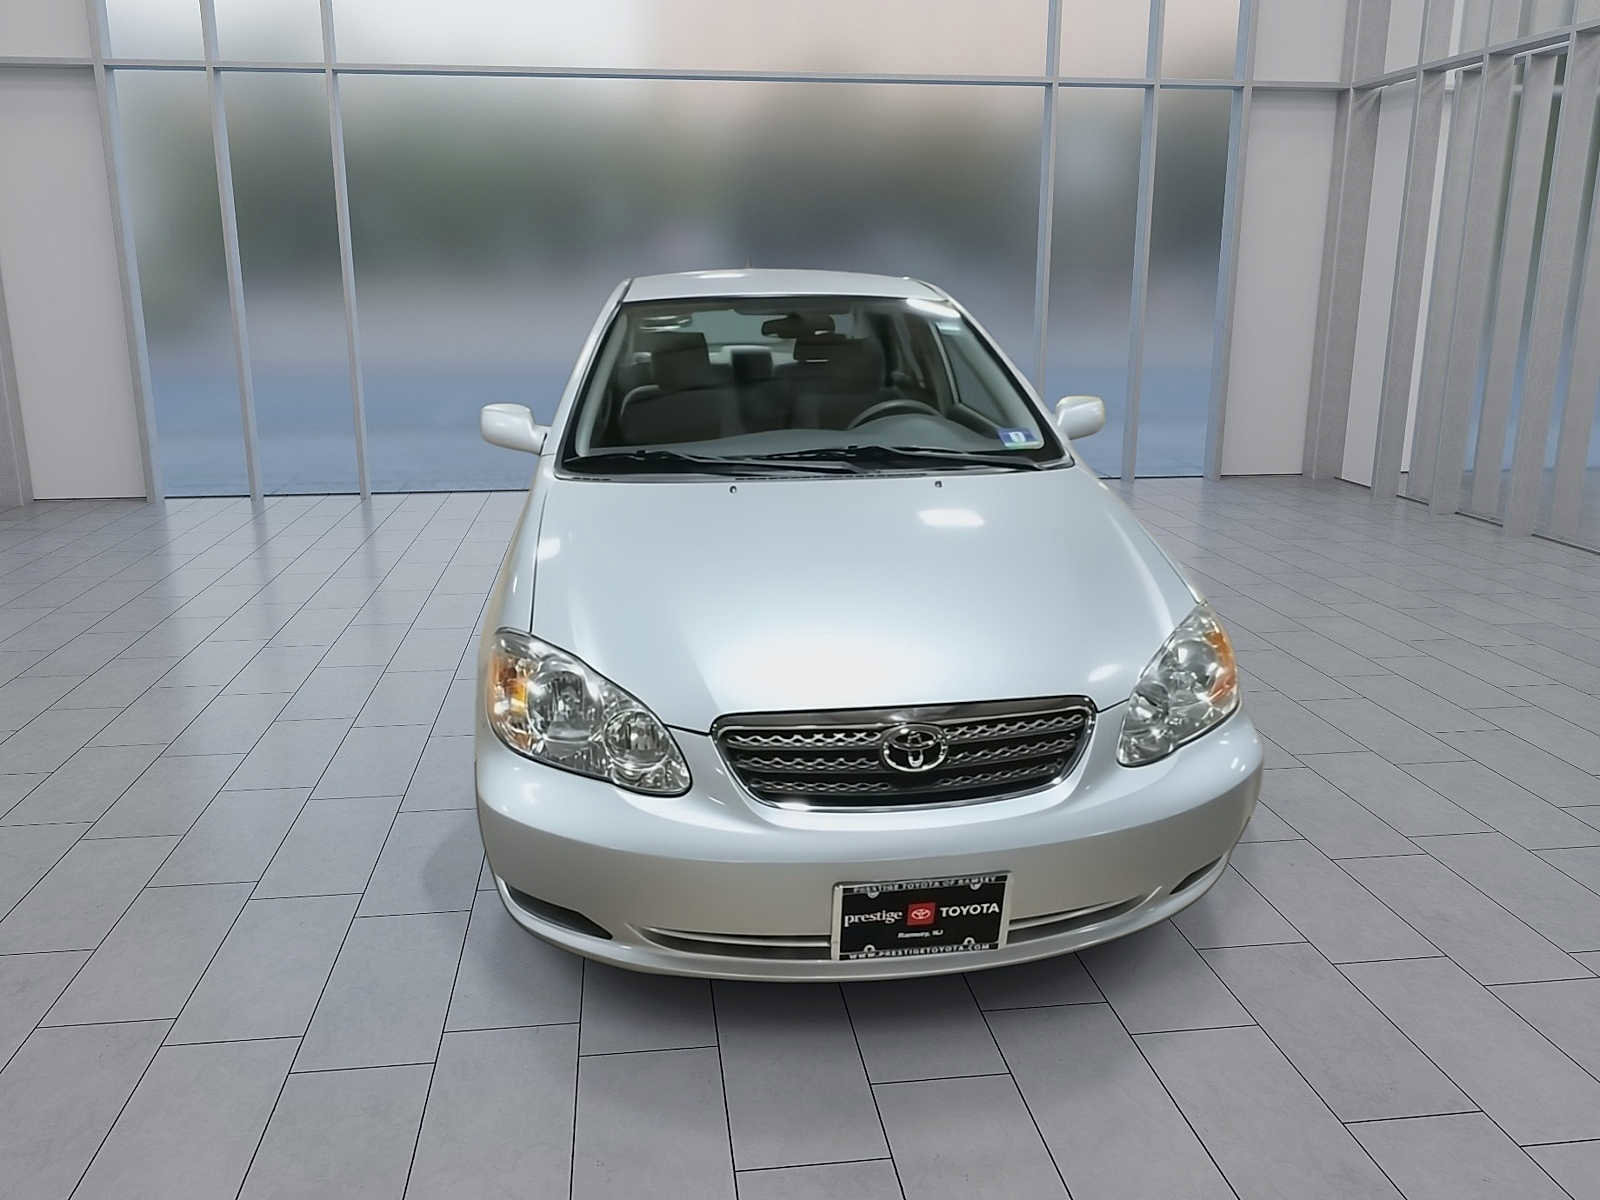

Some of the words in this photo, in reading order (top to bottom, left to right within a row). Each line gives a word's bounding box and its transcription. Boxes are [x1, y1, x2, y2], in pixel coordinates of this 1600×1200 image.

[902, 880, 942, 890] TOYOTA
[844, 909, 903, 927] prestige
[940, 903, 1000, 918] TOYOTA
